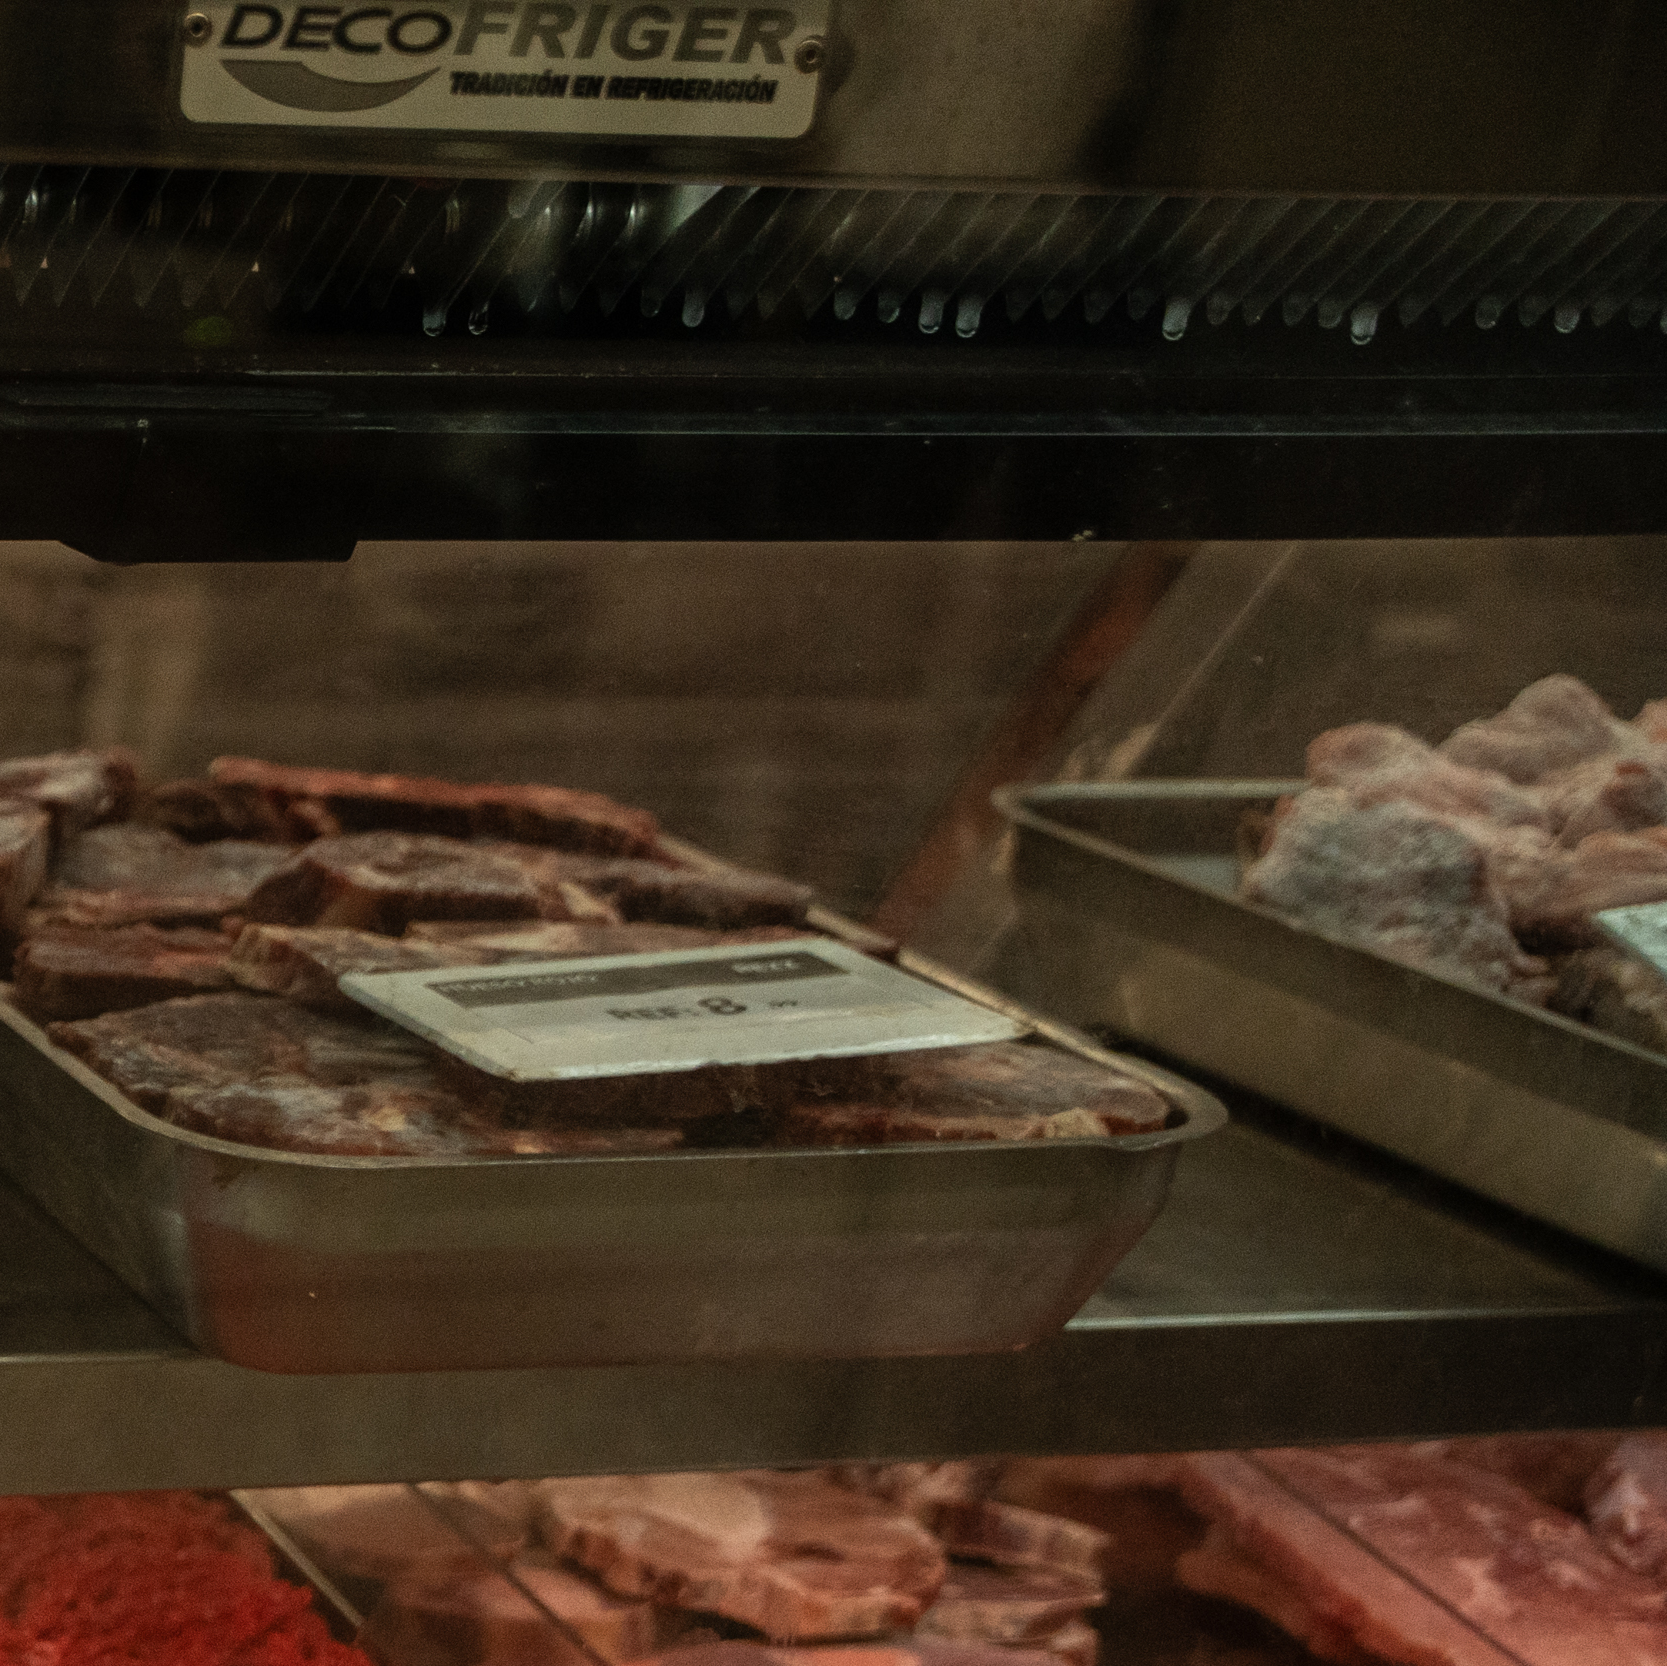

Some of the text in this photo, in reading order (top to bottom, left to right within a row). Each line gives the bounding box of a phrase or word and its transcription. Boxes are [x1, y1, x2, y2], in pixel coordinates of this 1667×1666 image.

[219, 1, 798, 66] DECOFRIGER
[450, 70, 779, 104] TRADICIÓN EN REFRIGERACIÓN
[698, 996, 748, 1017] 8
